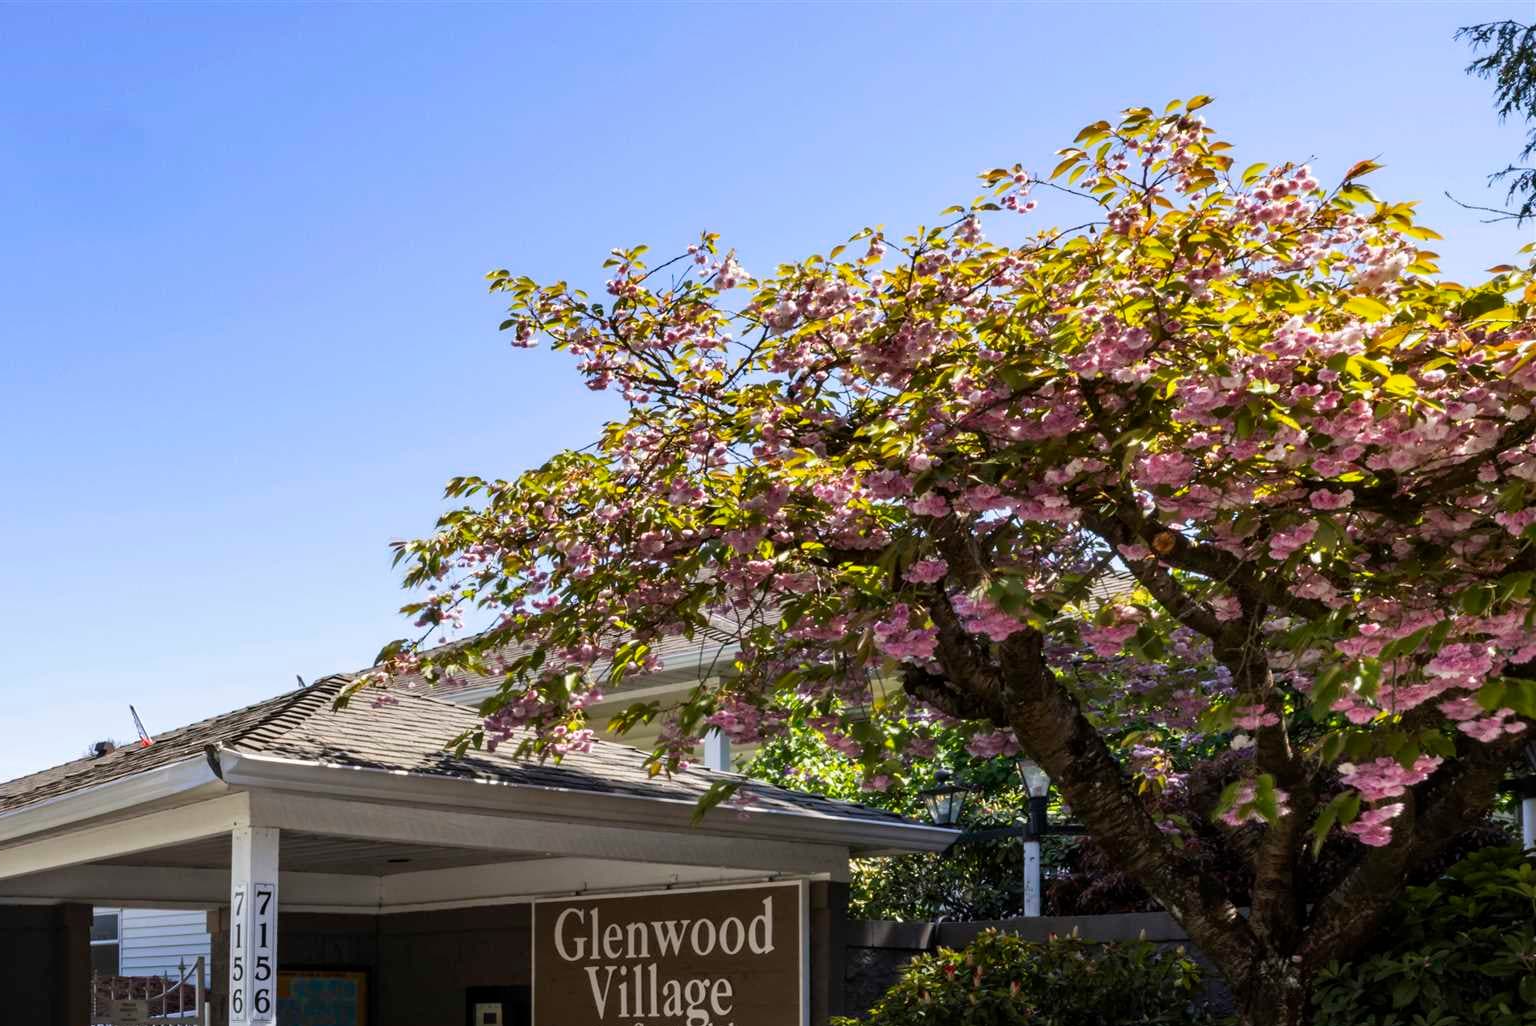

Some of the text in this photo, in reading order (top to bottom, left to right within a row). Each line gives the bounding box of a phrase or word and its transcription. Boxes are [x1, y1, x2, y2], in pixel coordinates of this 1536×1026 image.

[233, 892, 244, 1014] 7156
[255, 891, 272, 1014] 7156
[554, 895, 775, 961] Glenwood
